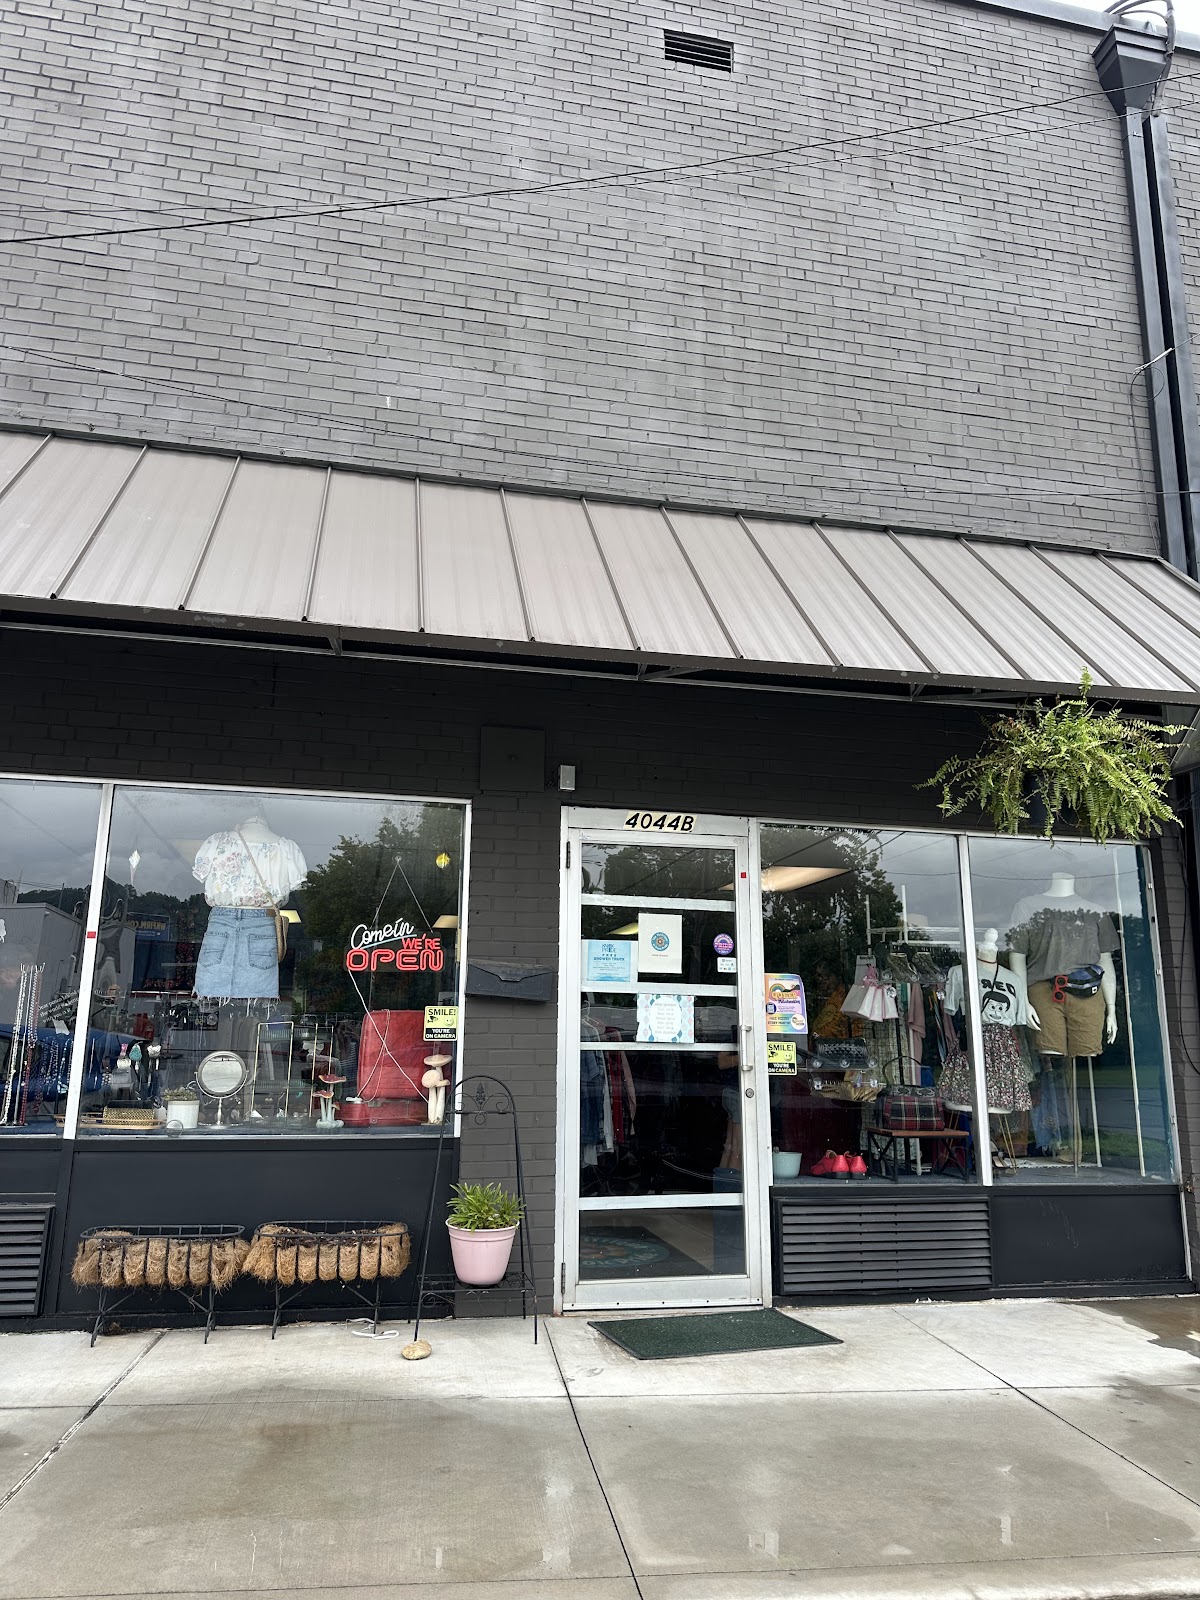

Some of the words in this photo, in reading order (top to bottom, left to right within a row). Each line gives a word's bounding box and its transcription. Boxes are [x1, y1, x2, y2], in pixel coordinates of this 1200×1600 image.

[625, 812, 695, 833] 4044B
[402, 933, 441, 950] WE'RE
[346, 949, 444, 971] OPEN
[978, 979, 1016, 998] RED
[428, 1008, 456, 1016] SMILE!
[768, 1043, 794, 1051] SMILE!
